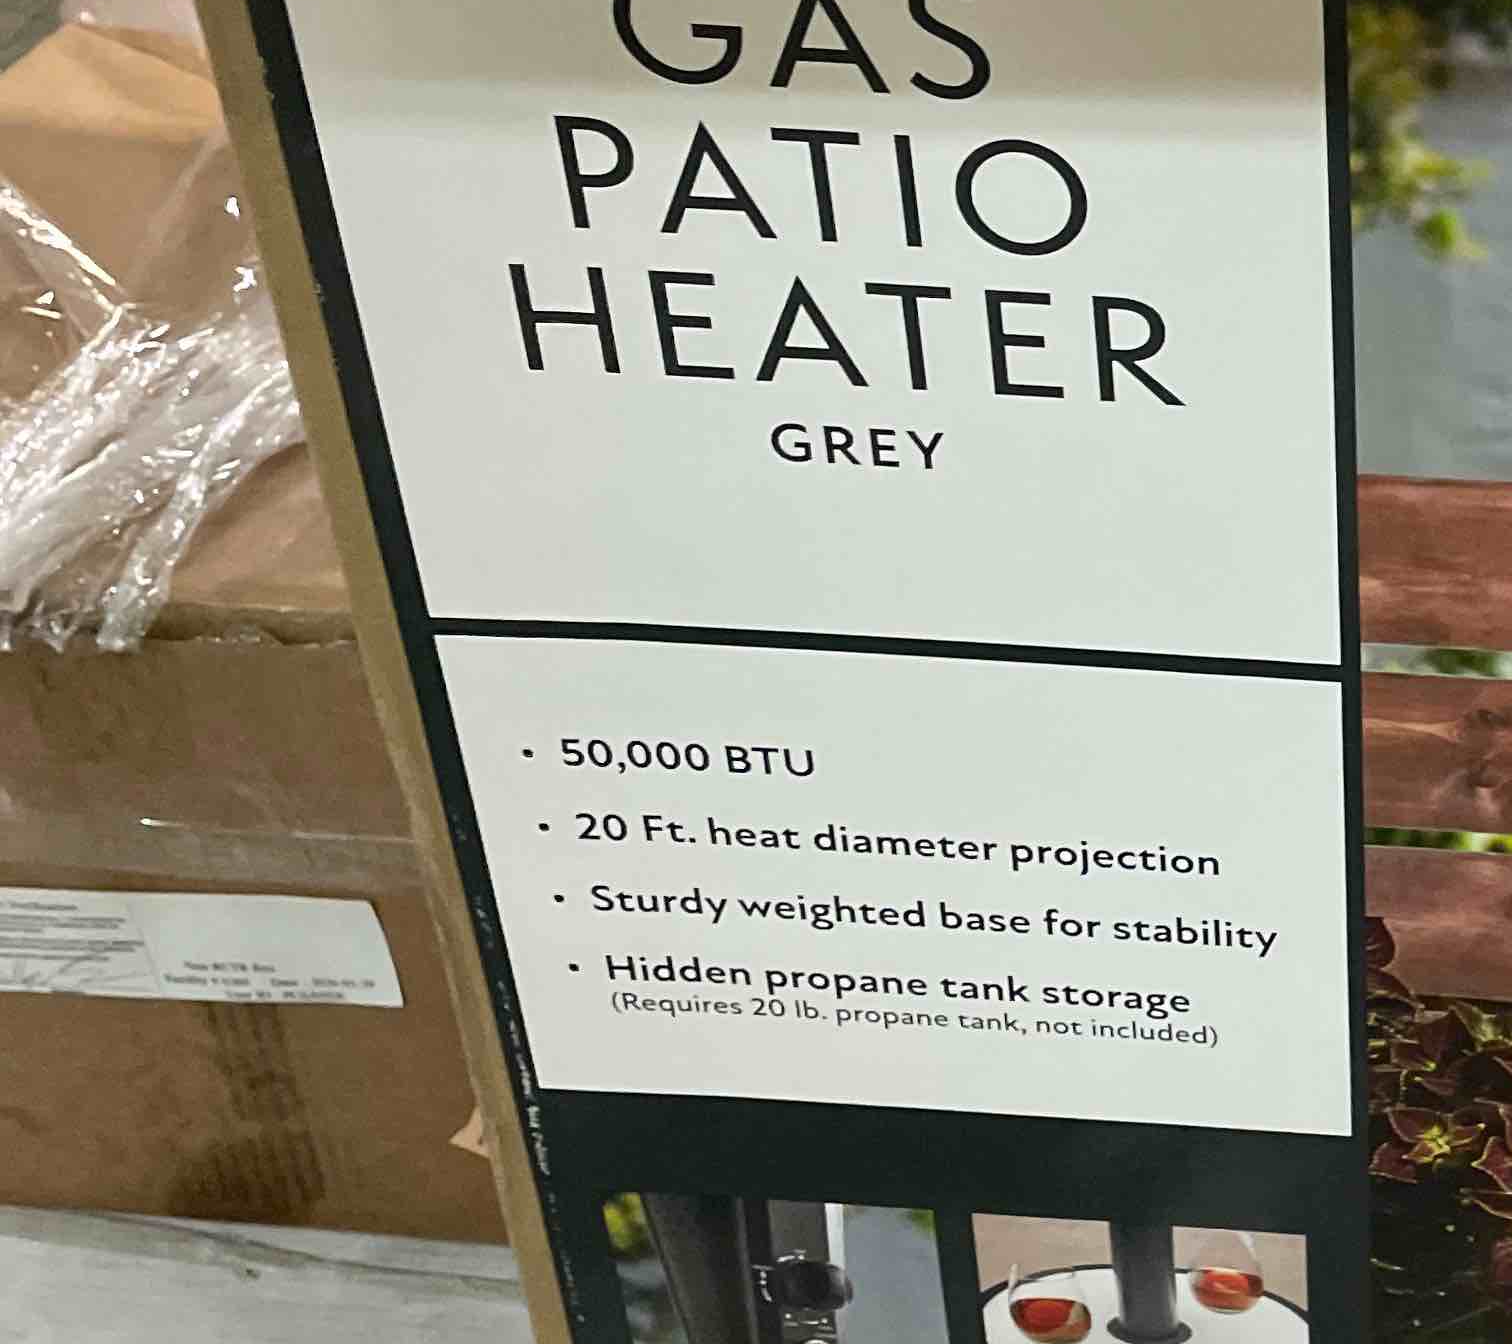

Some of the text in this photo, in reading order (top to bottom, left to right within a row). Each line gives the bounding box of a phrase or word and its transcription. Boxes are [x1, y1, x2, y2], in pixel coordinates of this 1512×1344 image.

[553, 115, 1088, 256] PATIO
[508, 263, 1187, 407] HEATER
[771, 423, 943, 470] GREY
[561, 738, 815, 776] 50,000 BTU
[575, 813, 1220, 875] 20 Ft. heat diameter projection
[591, 884, 1277, 957] Sturdy weighted base for stability
[606, 955, 1191, 1019] Hidden propane tank storage
[611, 991, 1218, 1048] (Requires 20 lb. propane tank, not included)
